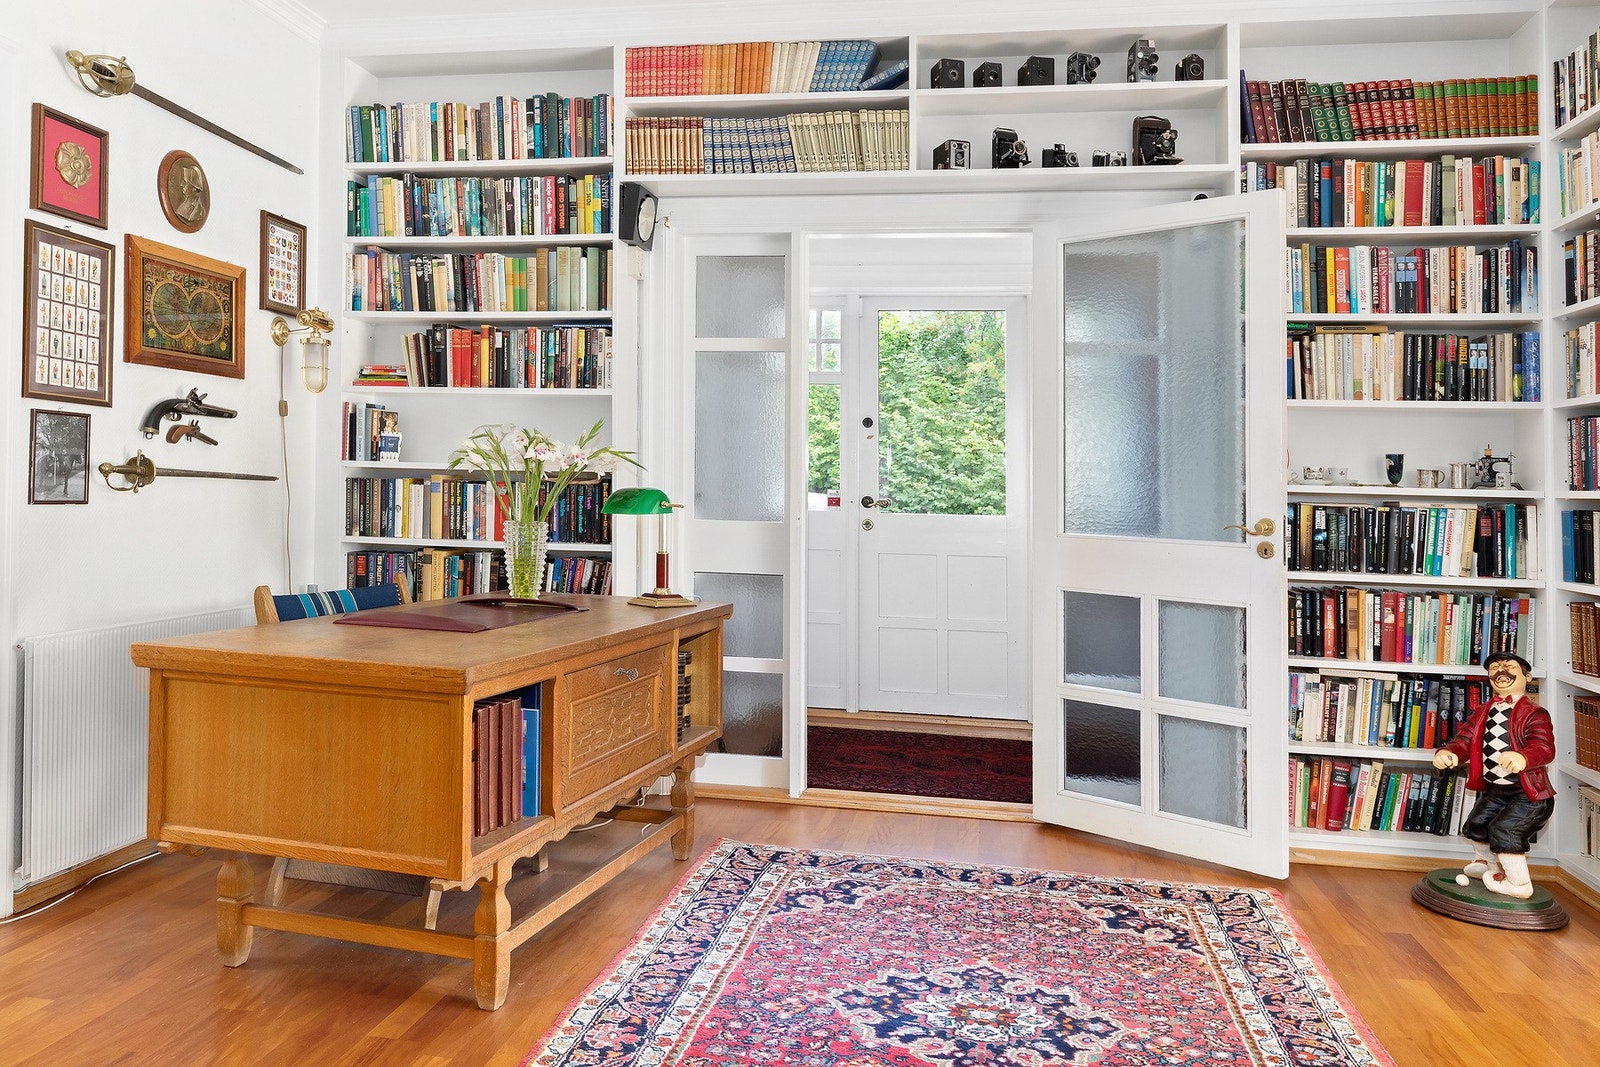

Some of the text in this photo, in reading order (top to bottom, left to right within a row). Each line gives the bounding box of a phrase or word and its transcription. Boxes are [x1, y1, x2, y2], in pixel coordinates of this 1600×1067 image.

[545, 178, 553, 196] Jackie
[1298, 183, 1308, 218] Banken
[1357, 770, 1369, 798] Ruth Rendell
[1370, 768, 1380, 789] Rendell
[1430, 787, 1439, 803] Rankin
[1445, 782, 1454, 797] Rankin
